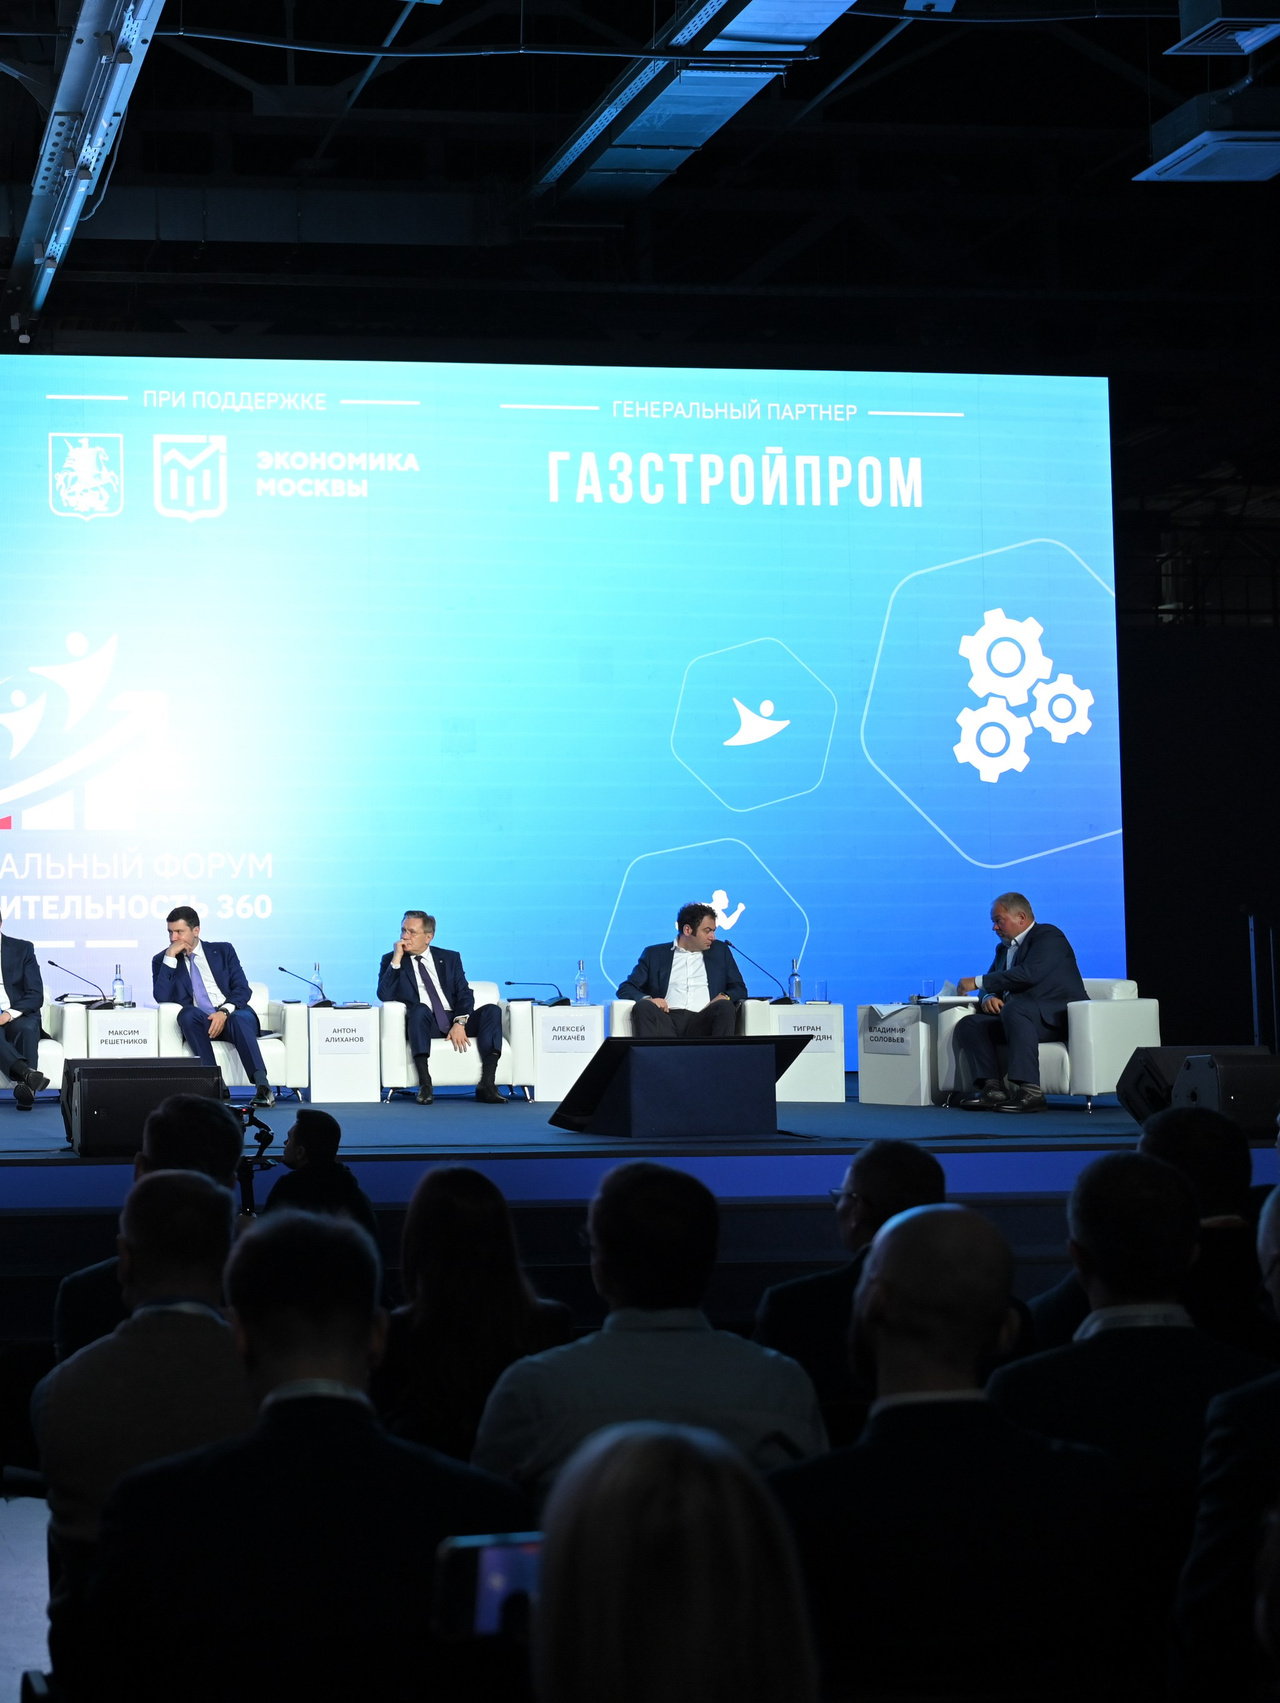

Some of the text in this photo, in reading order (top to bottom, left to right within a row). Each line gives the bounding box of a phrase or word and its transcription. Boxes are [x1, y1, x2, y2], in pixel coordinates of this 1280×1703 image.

[143, 390, 327, 412] ПРИ ПОДДЕРЖКЕ
[613, 399, 858, 421] ГЕНЕРАЛЬНЫЙ ПАРТНЕР
[256, 450, 421, 472] ЭКОНОМИКА
[256, 478, 368, 498] МОСКВЫ
[548, 446, 923, 508] ГАЗСТРОЙПРОМ
[153, 852, 273, 880] ФОРУМ
[216, 894, 273, 920] 360
[868, 1026, 906, 1034] ВЛАДИМИР
[869, 1035, 905, 1043] СОЛОВЬЕВ
